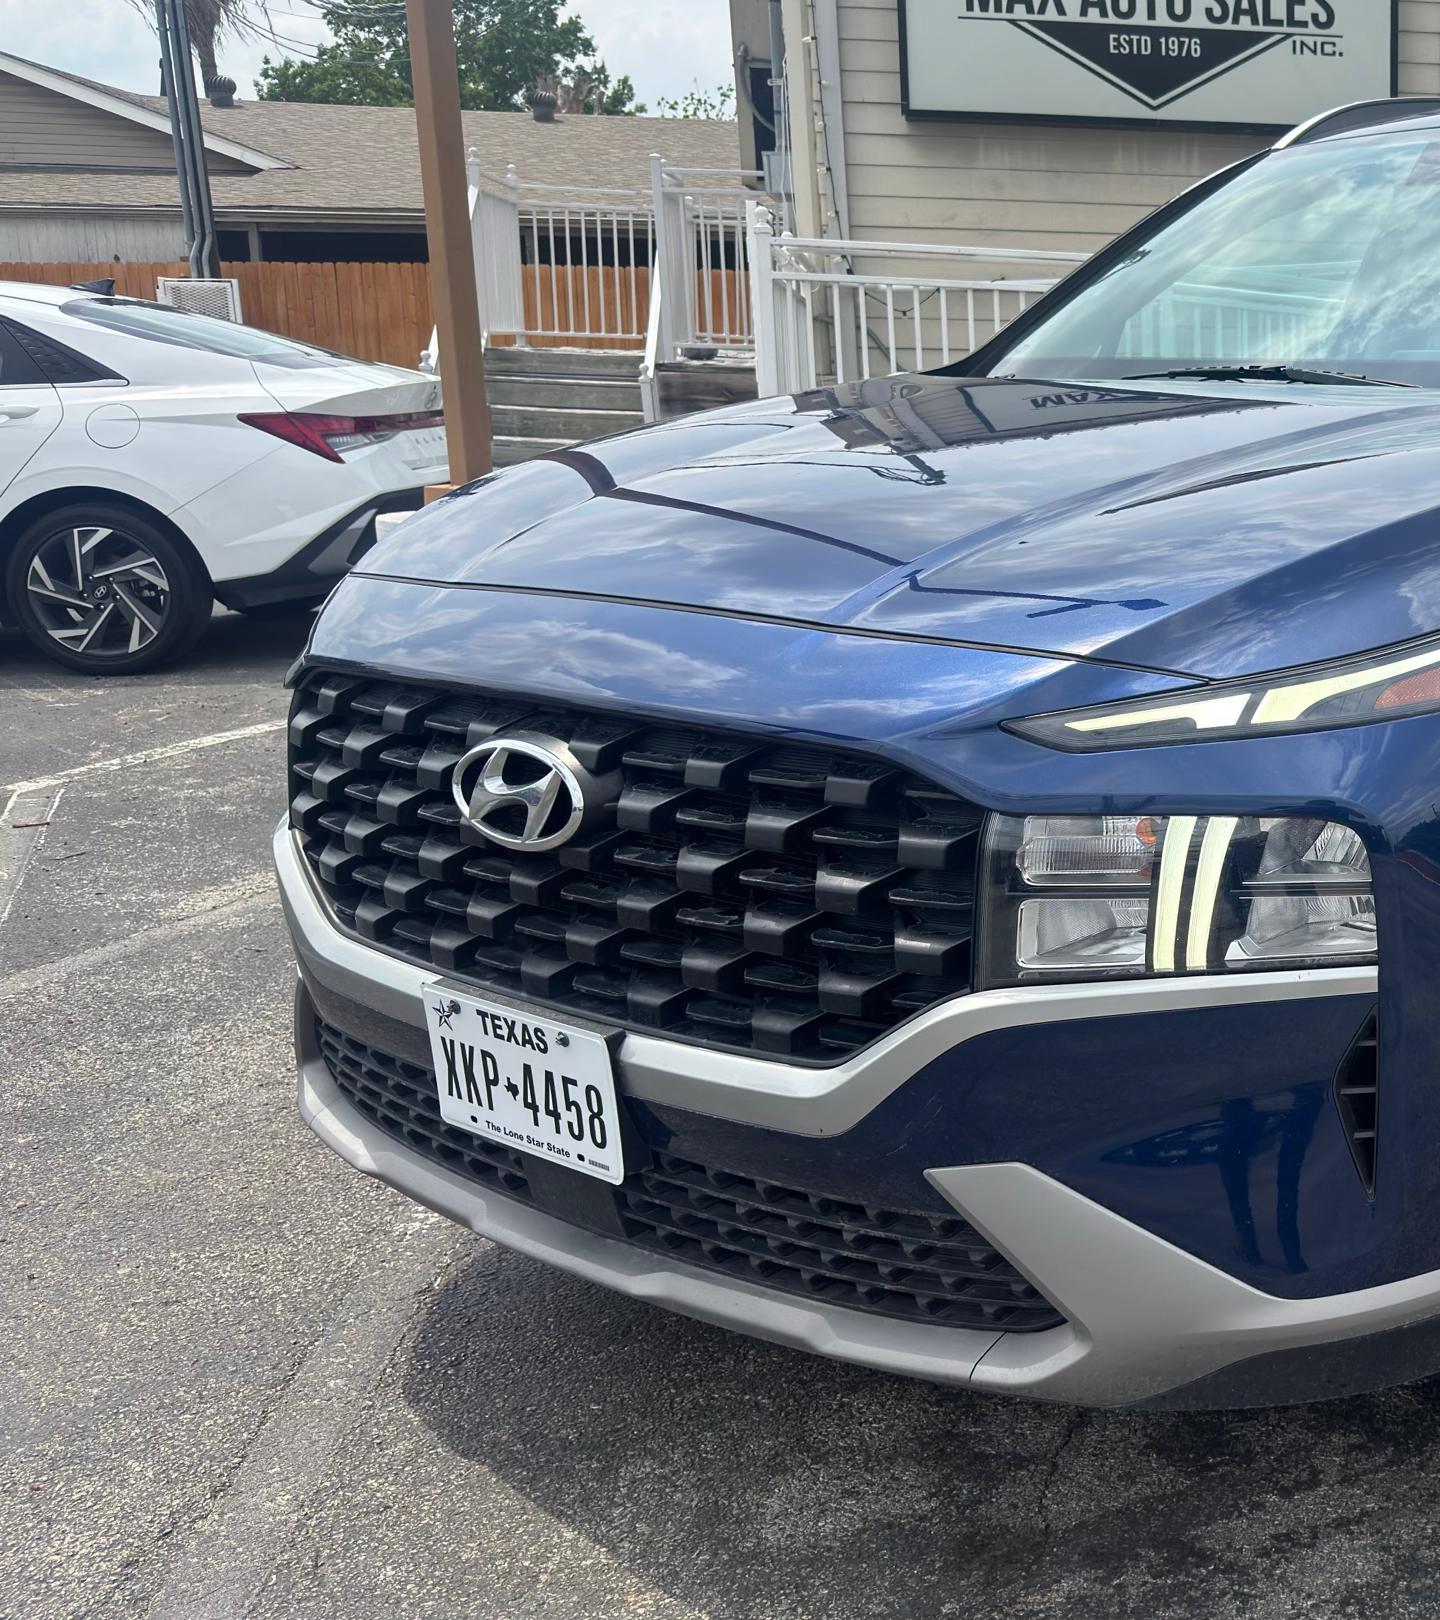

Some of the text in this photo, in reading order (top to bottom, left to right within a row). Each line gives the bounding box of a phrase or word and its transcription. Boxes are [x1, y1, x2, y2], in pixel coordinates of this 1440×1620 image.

[1109, 34, 1201, 57] ESTD 1976
[1293, 40, 1344, 57] INC.
[476, 1008, 549, 1054] TEXAS
[441, 1036, 608, 1150] XKP 4458
[485, 1119, 571, 1158] The Lone Star State
